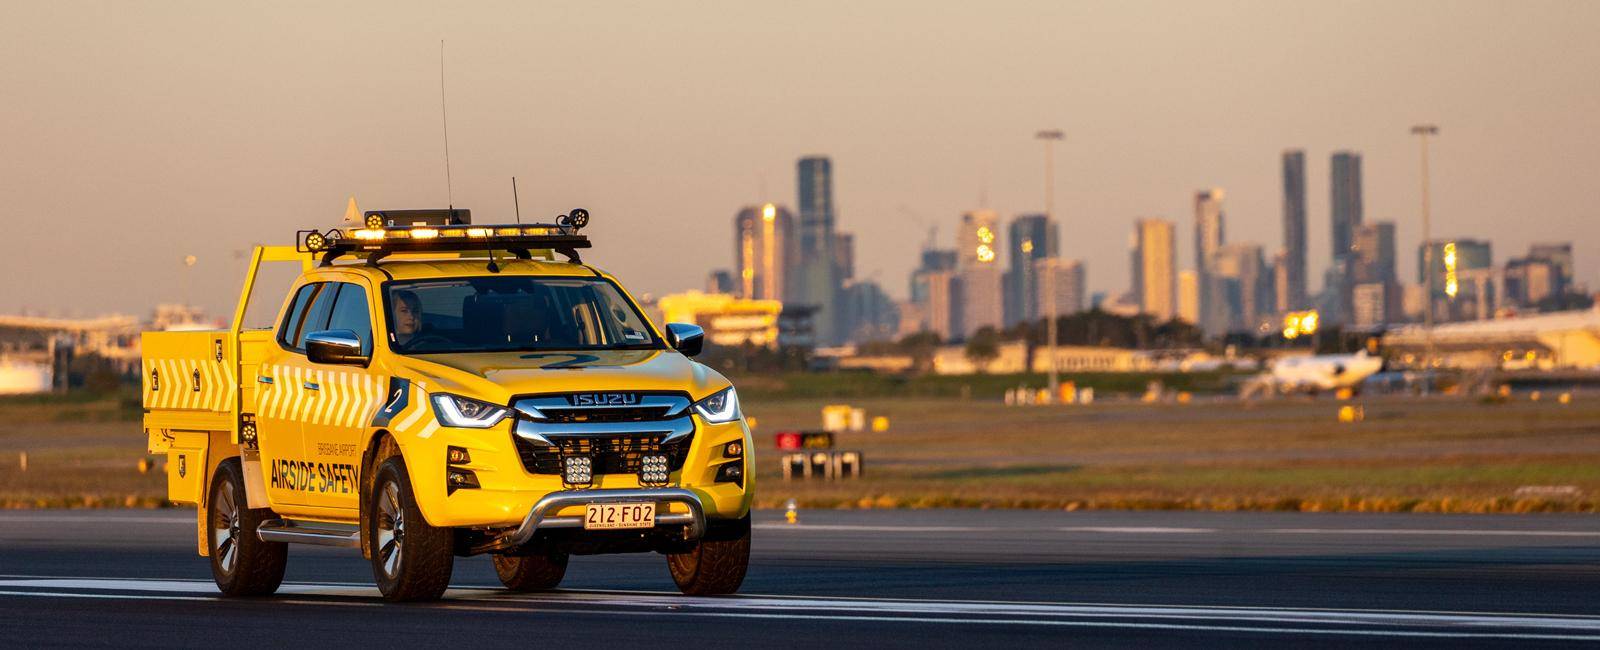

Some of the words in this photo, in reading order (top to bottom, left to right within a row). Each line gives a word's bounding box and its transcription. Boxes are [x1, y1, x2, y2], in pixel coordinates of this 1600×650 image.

[384, 388, 402, 412] 2
[573, 393, 636, 406] ISUZU
[271, 458, 316, 492] AIRSIDE
[317, 462, 359, 493] SAFETY
